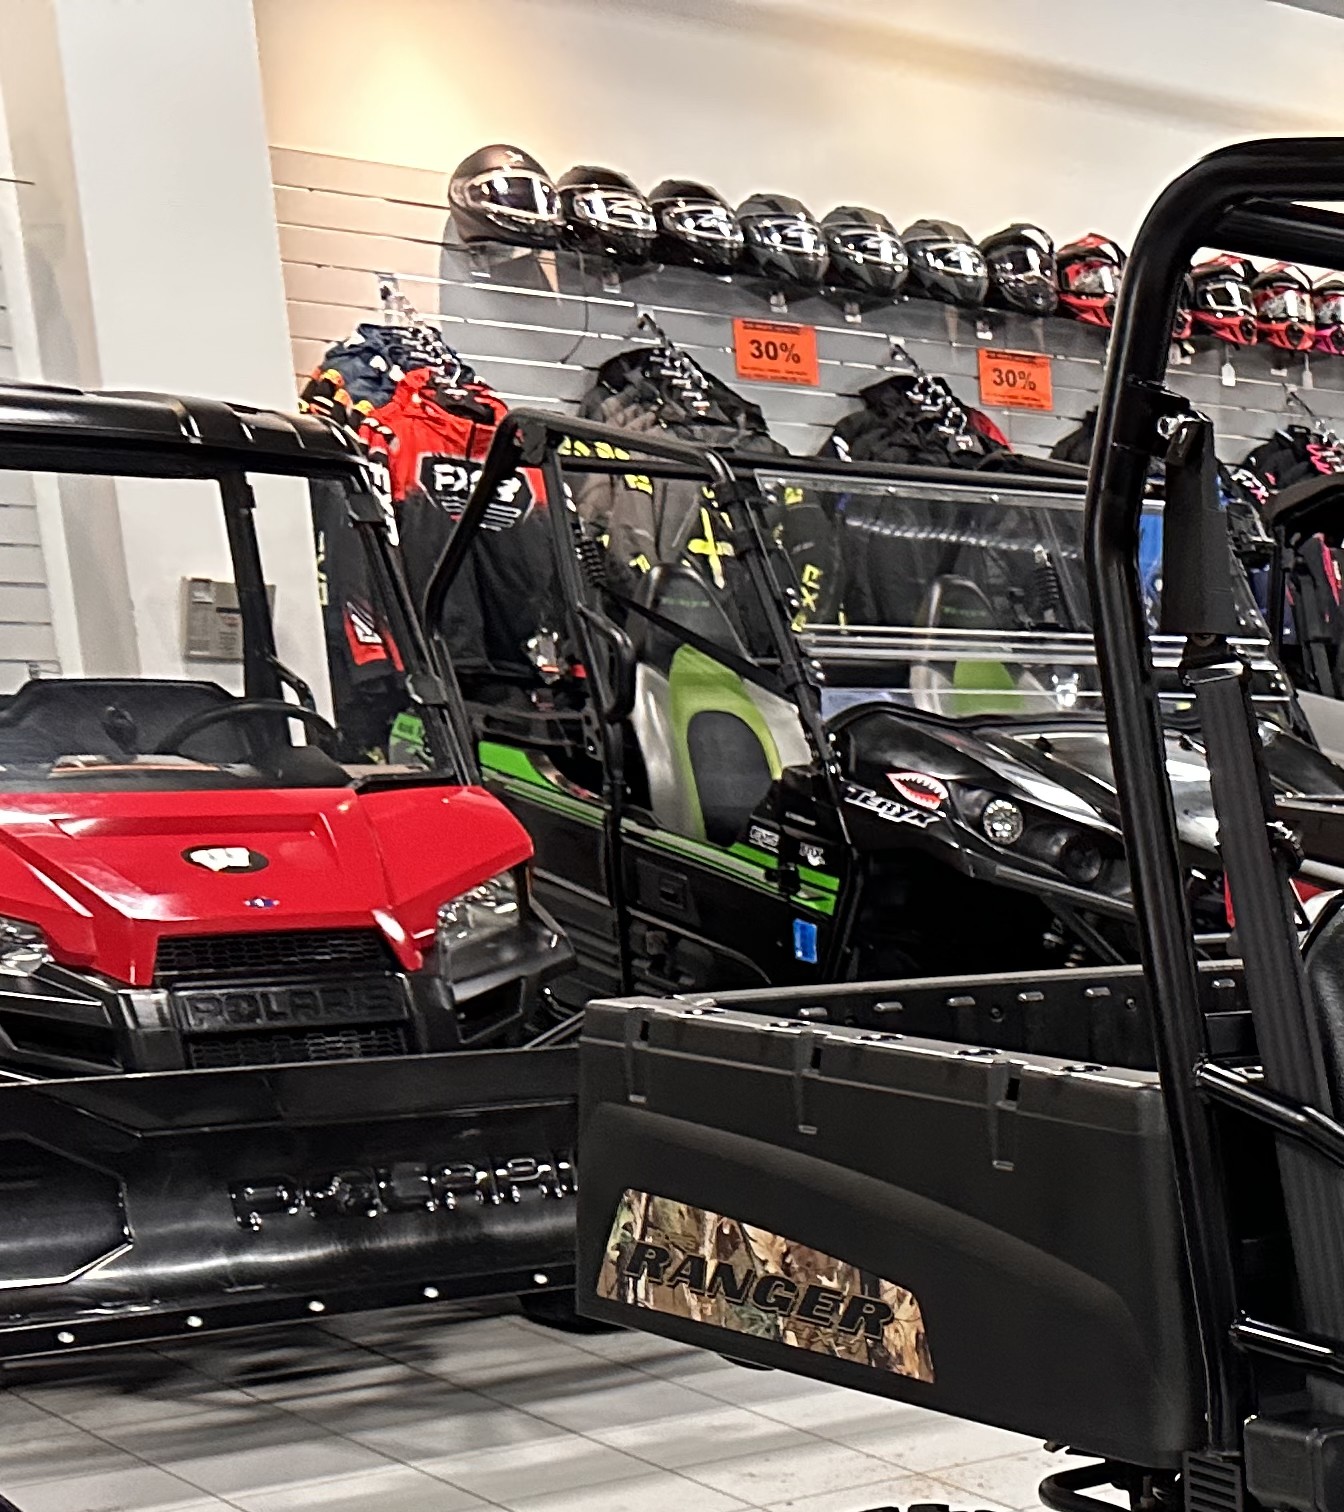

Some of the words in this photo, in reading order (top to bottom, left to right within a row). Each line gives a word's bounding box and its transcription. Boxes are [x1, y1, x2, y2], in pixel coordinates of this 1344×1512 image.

[748, 339, 802, 365] 30%
[992, 367, 1037, 391] 30%
[623, 1239, 895, 1341] RANGER
